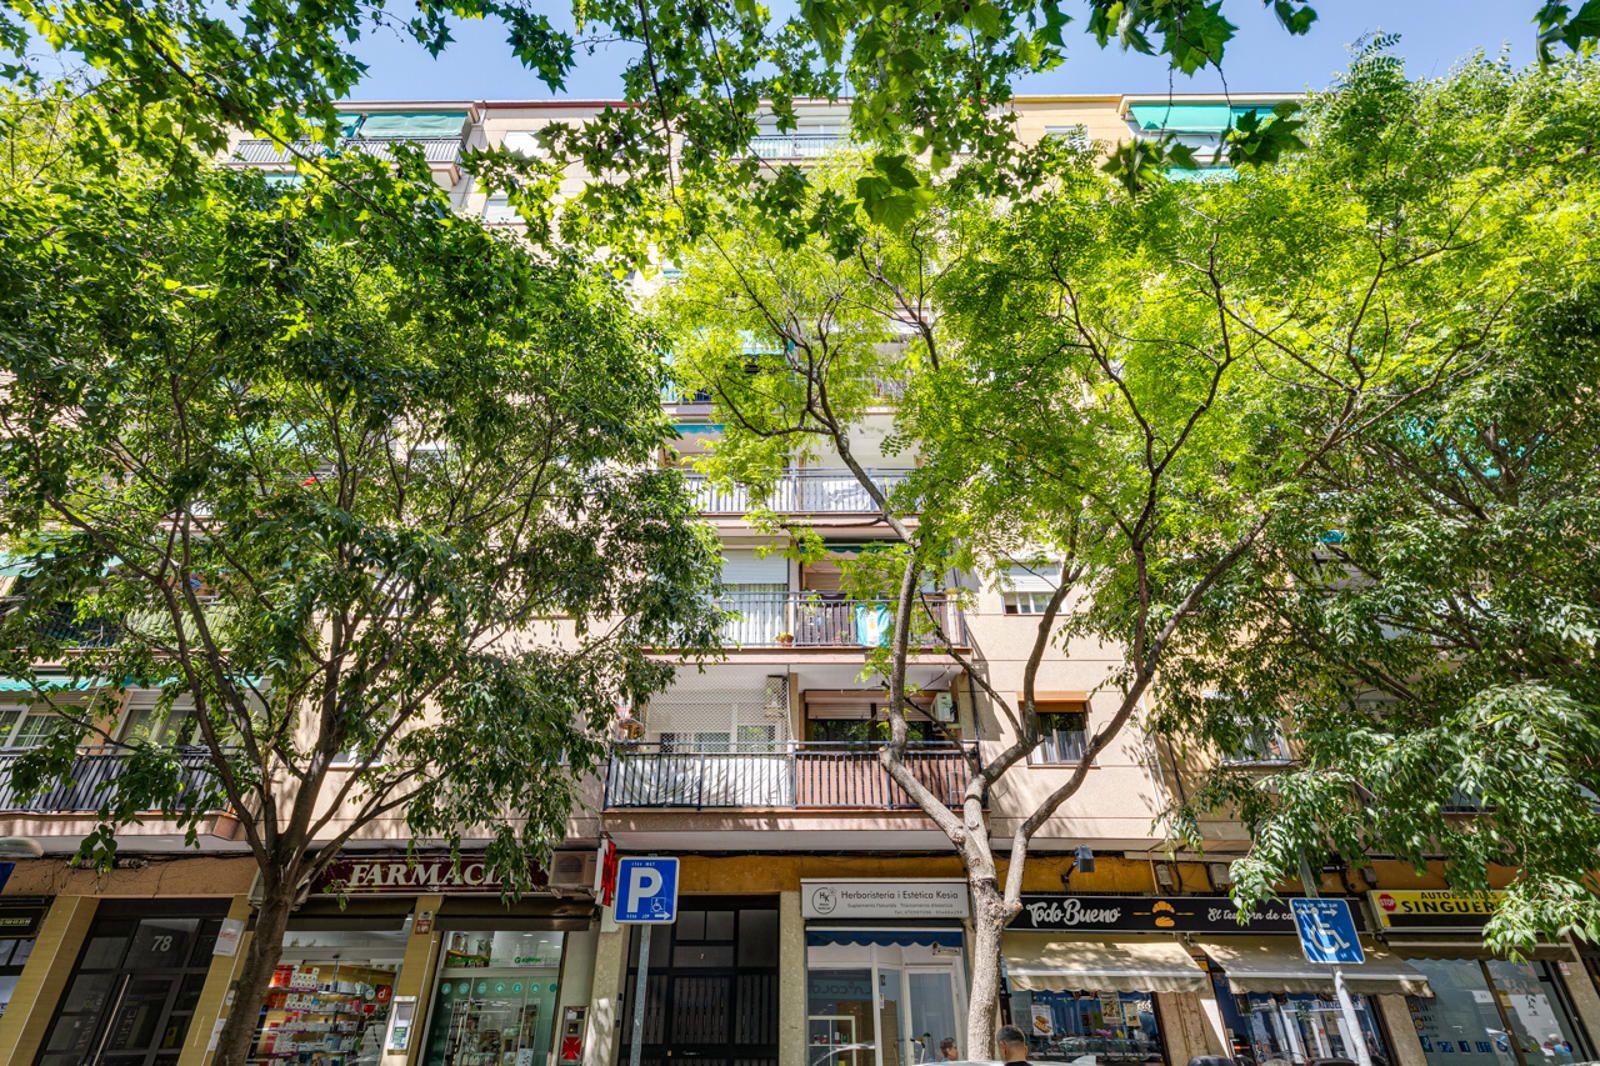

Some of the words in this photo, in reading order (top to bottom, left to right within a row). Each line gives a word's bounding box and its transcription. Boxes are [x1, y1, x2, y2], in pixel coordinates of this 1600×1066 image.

[627, 867, 663, 912] P
[1420, 891, 1498, 900] AUTOEOLS
[1379, 898, 1395, 906] STOP
[1401, 900, 1499, 912] SINGUER
[1025, 901, 1064, 927] Todo
[1063, 898, 1120, 925] Bueno
[1265, 909, 1279, 920] de
[151, 936, 173, 951] 78
